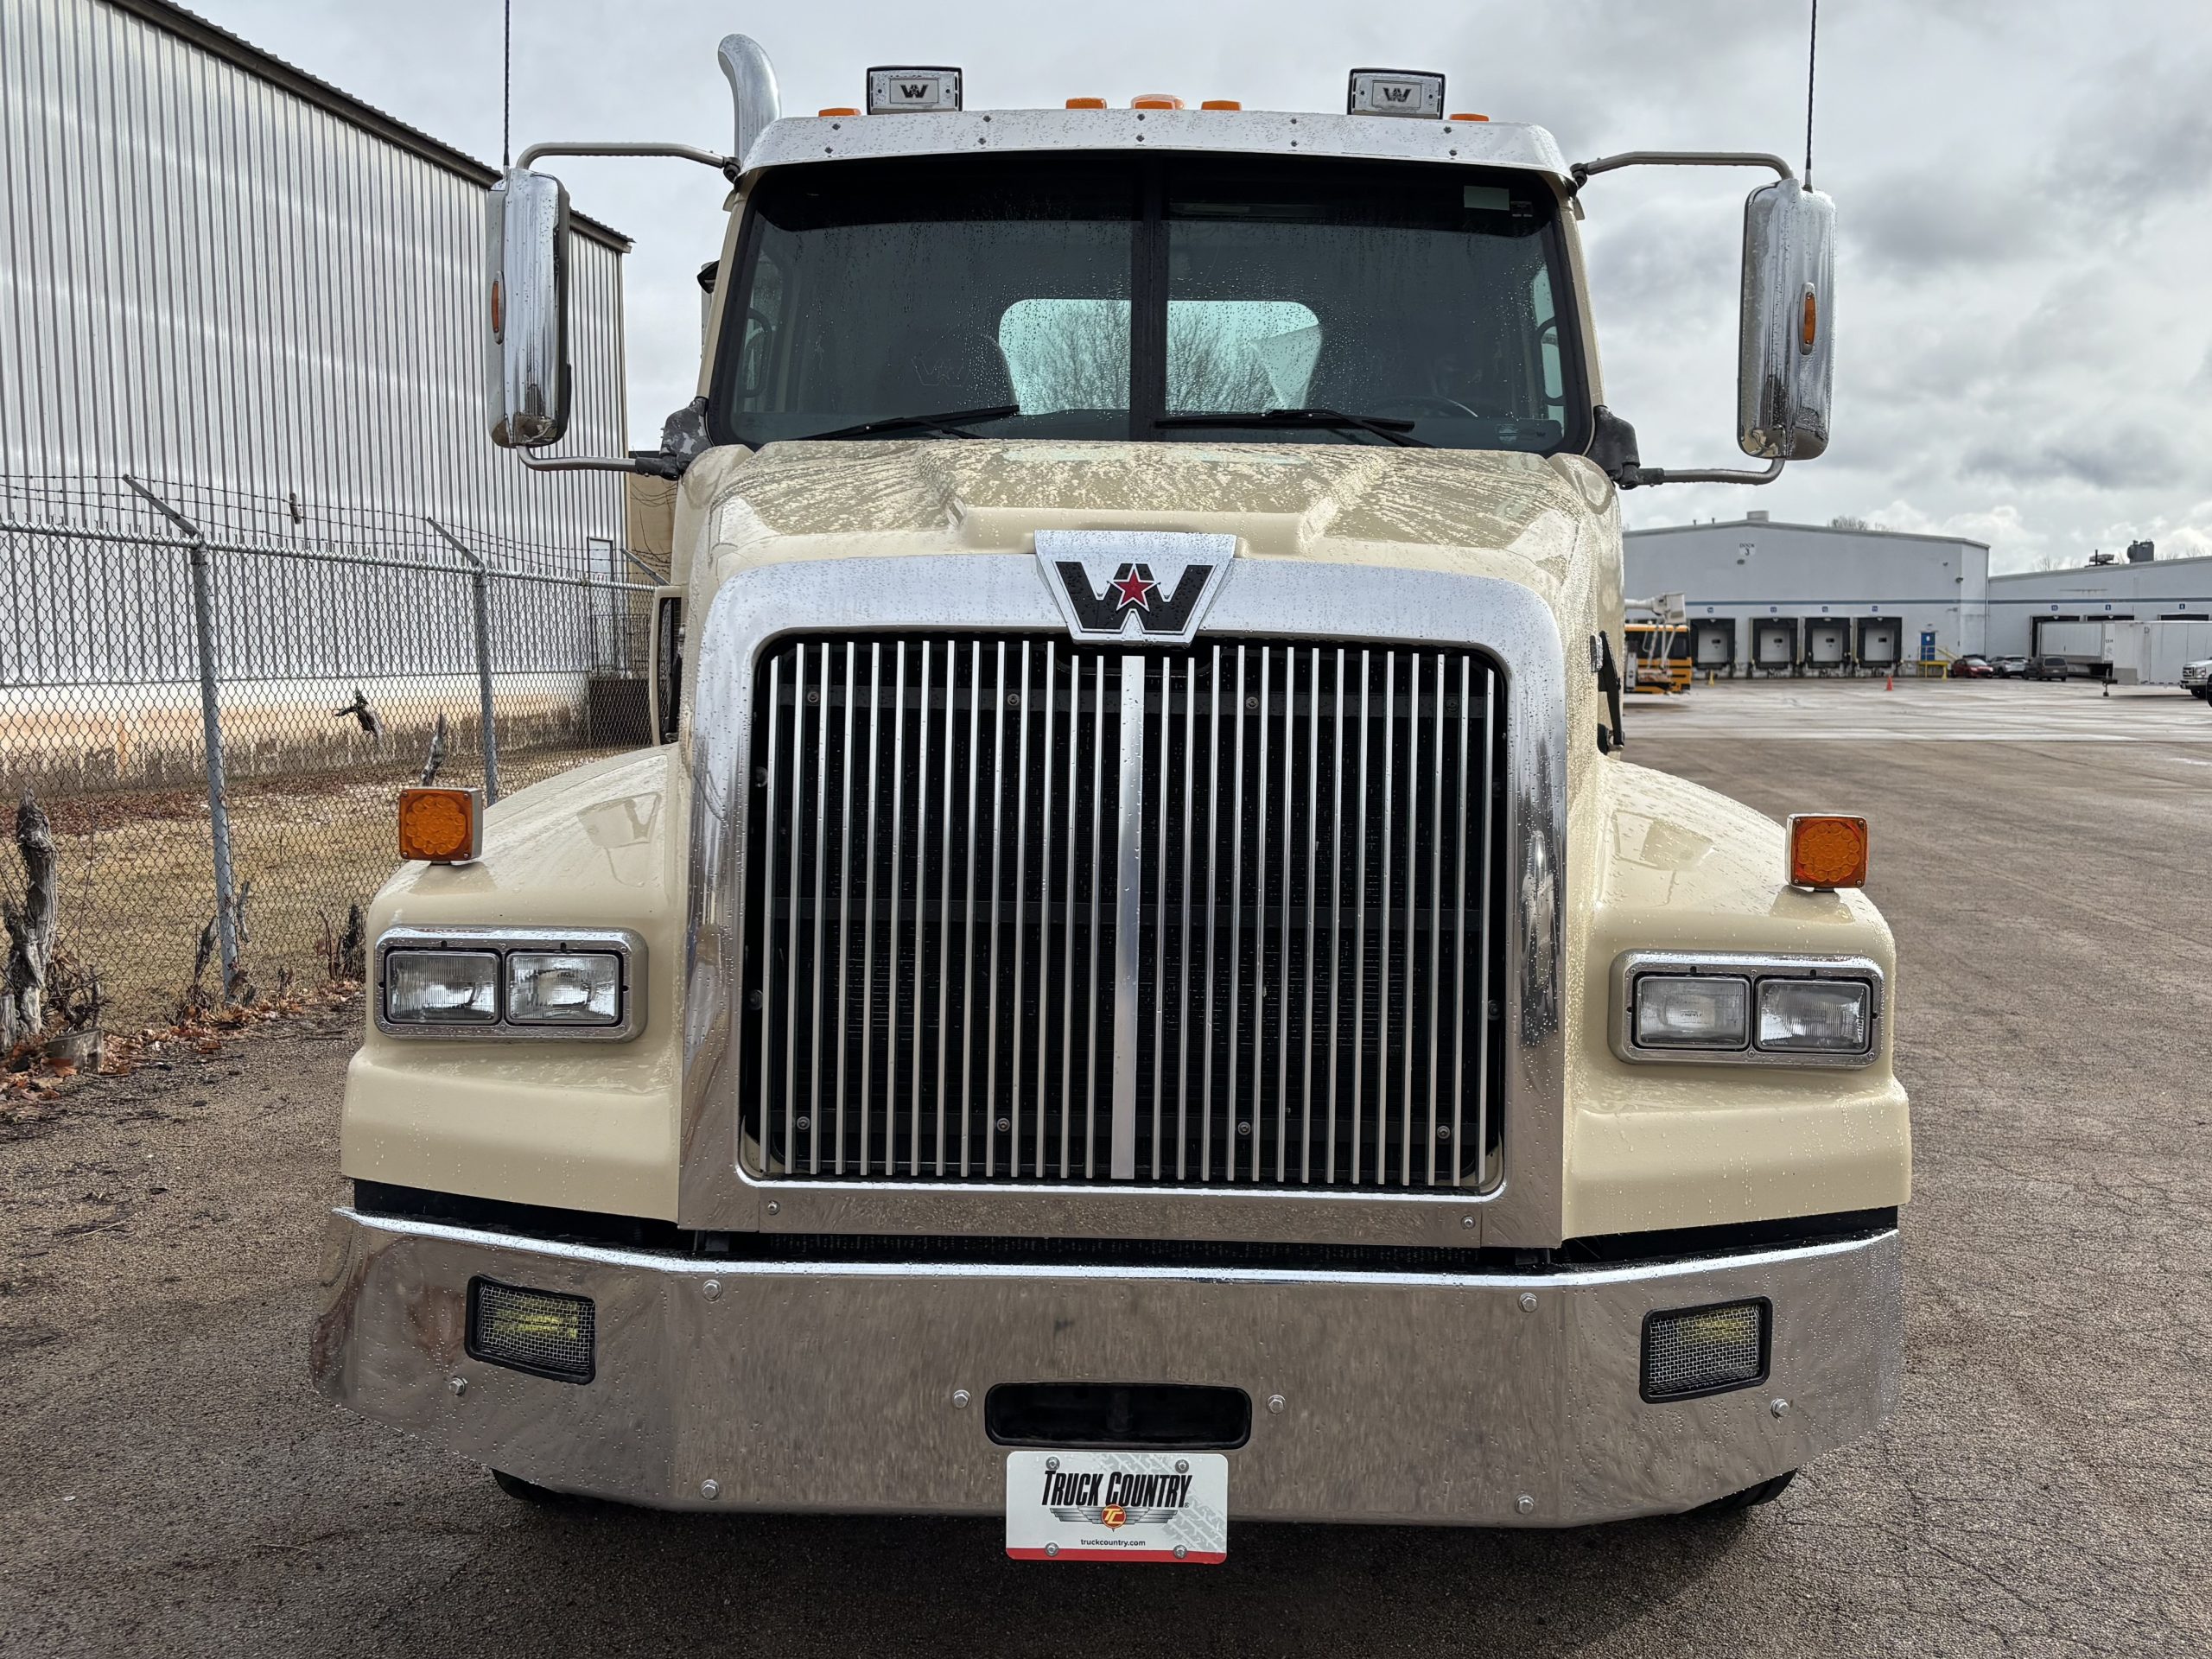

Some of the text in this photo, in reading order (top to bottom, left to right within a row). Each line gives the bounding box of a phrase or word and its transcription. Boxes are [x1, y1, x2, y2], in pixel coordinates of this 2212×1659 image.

[1041, 1470, 1192, 1508] TRUCK COUNTRY
[1080, 1538, 1146, 1548] truckcountry.com
